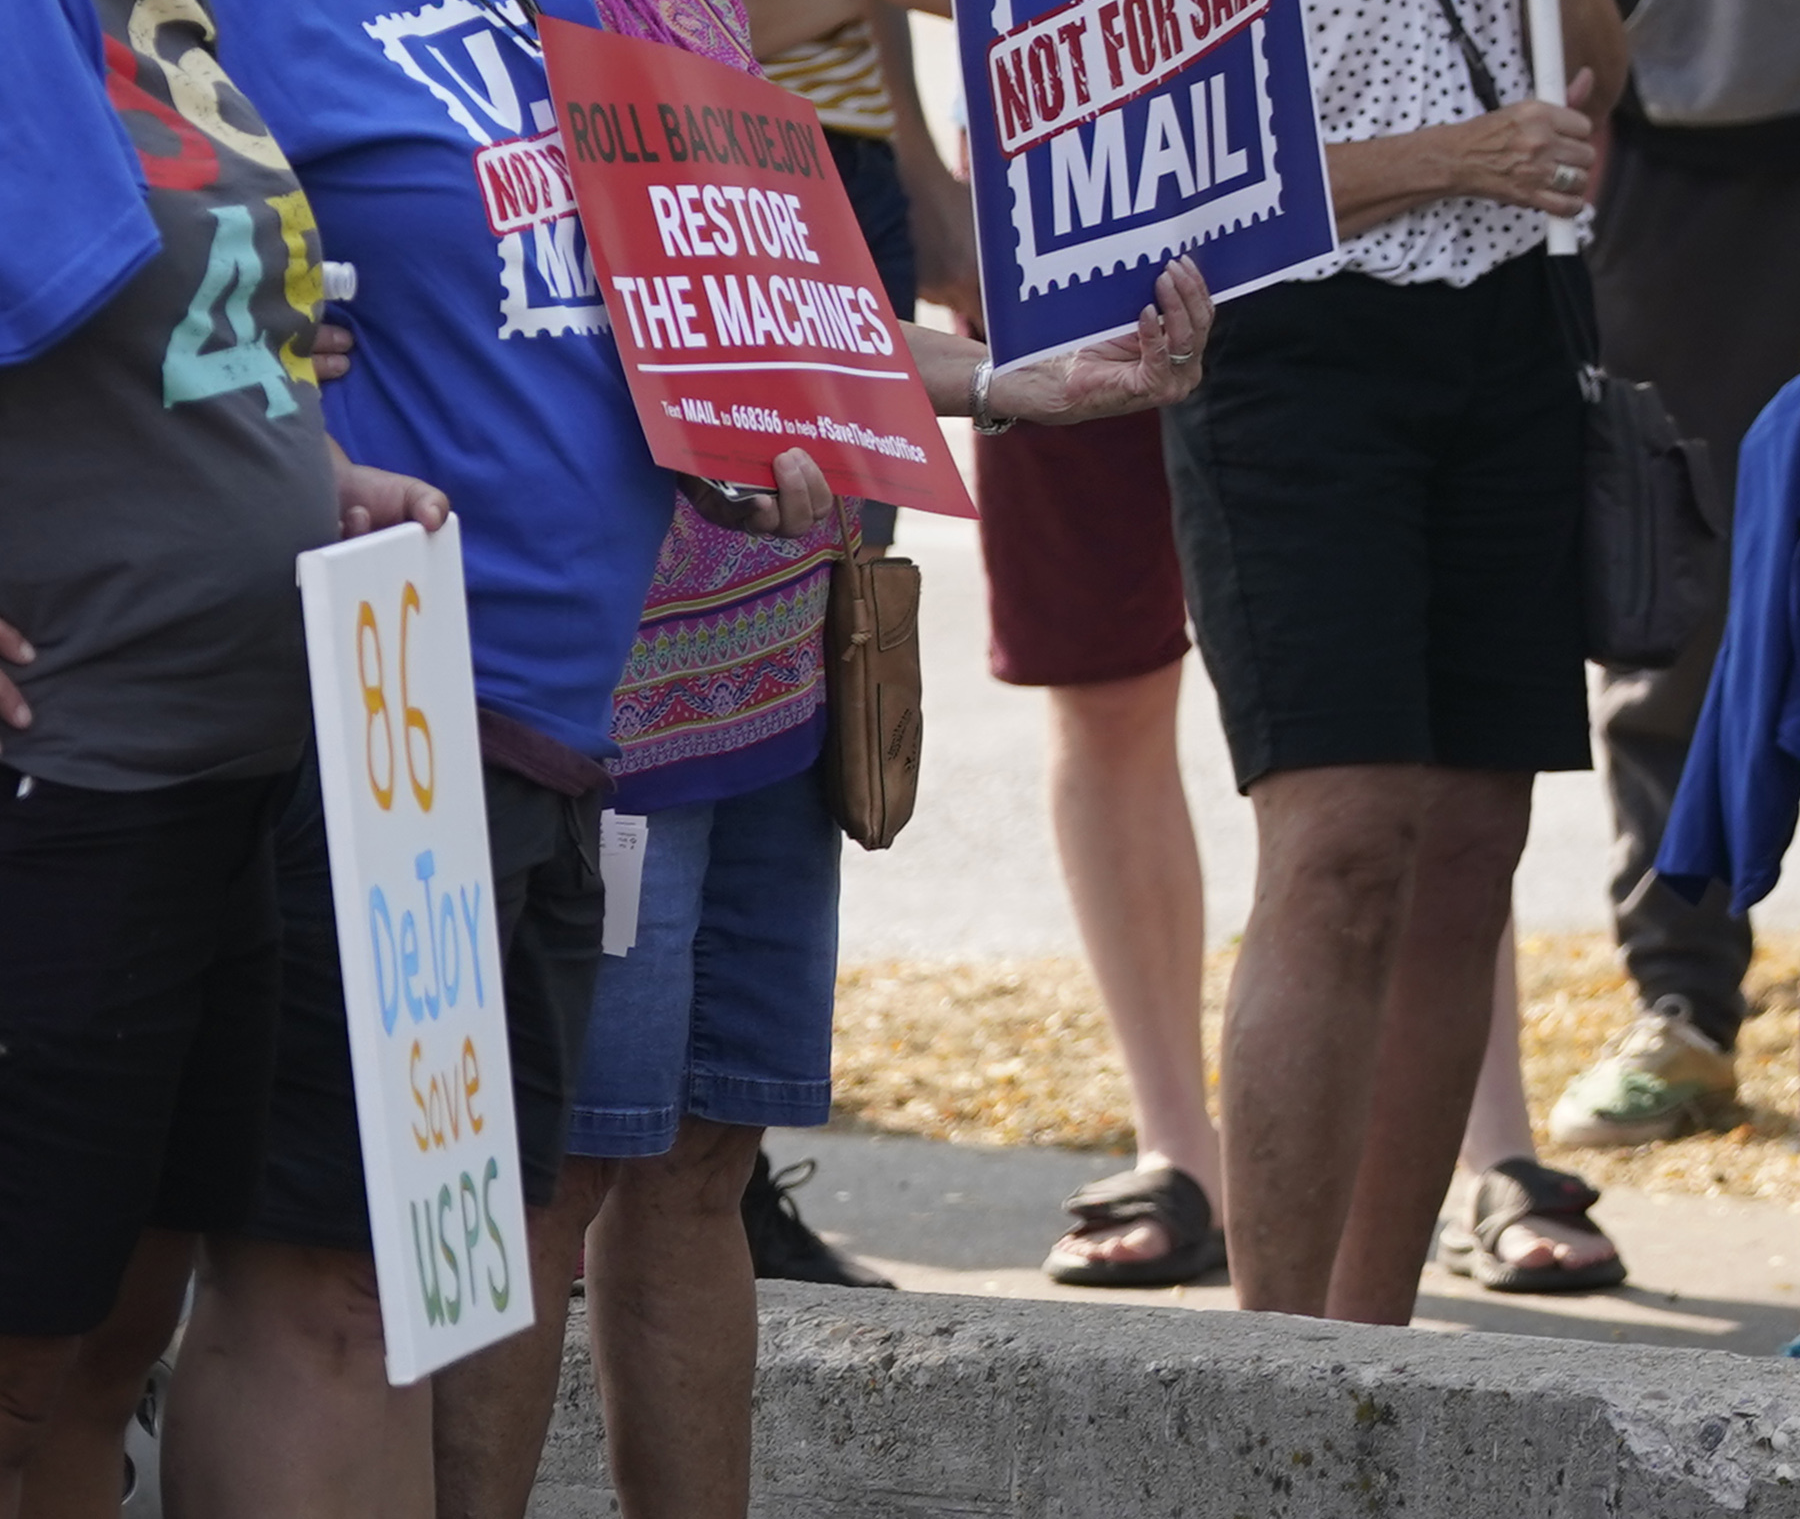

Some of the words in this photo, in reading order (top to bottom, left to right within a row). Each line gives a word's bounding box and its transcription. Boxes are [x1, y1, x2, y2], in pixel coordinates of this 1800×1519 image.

[995, 16, 1087, 141] NOT
[567, 102, 660, 163] ROLL
[657, 103, 750, 166] BACK
[741, 111, 825, 180] DEJOY
[1050, 72, 1248, 237] MAIL
[648, 184, 820, 264] RESTORE
[612, 276, 707, 349] THE
[703, 274, 894, 356] MACHINES
[661, 401, 682, 420] Text
[681, 398, 721, 427] MAIL
[720, 413, 732, 426] to
[731, 404, 783, 435] 668366
[784, 420, 796, 435] to
[795, 421, 818, 440] help
[817, 415, 927, 464] #SaveThePostOffice
[357, 579, 434, 812] 86
[410, 1036, 483, 1152] Save
